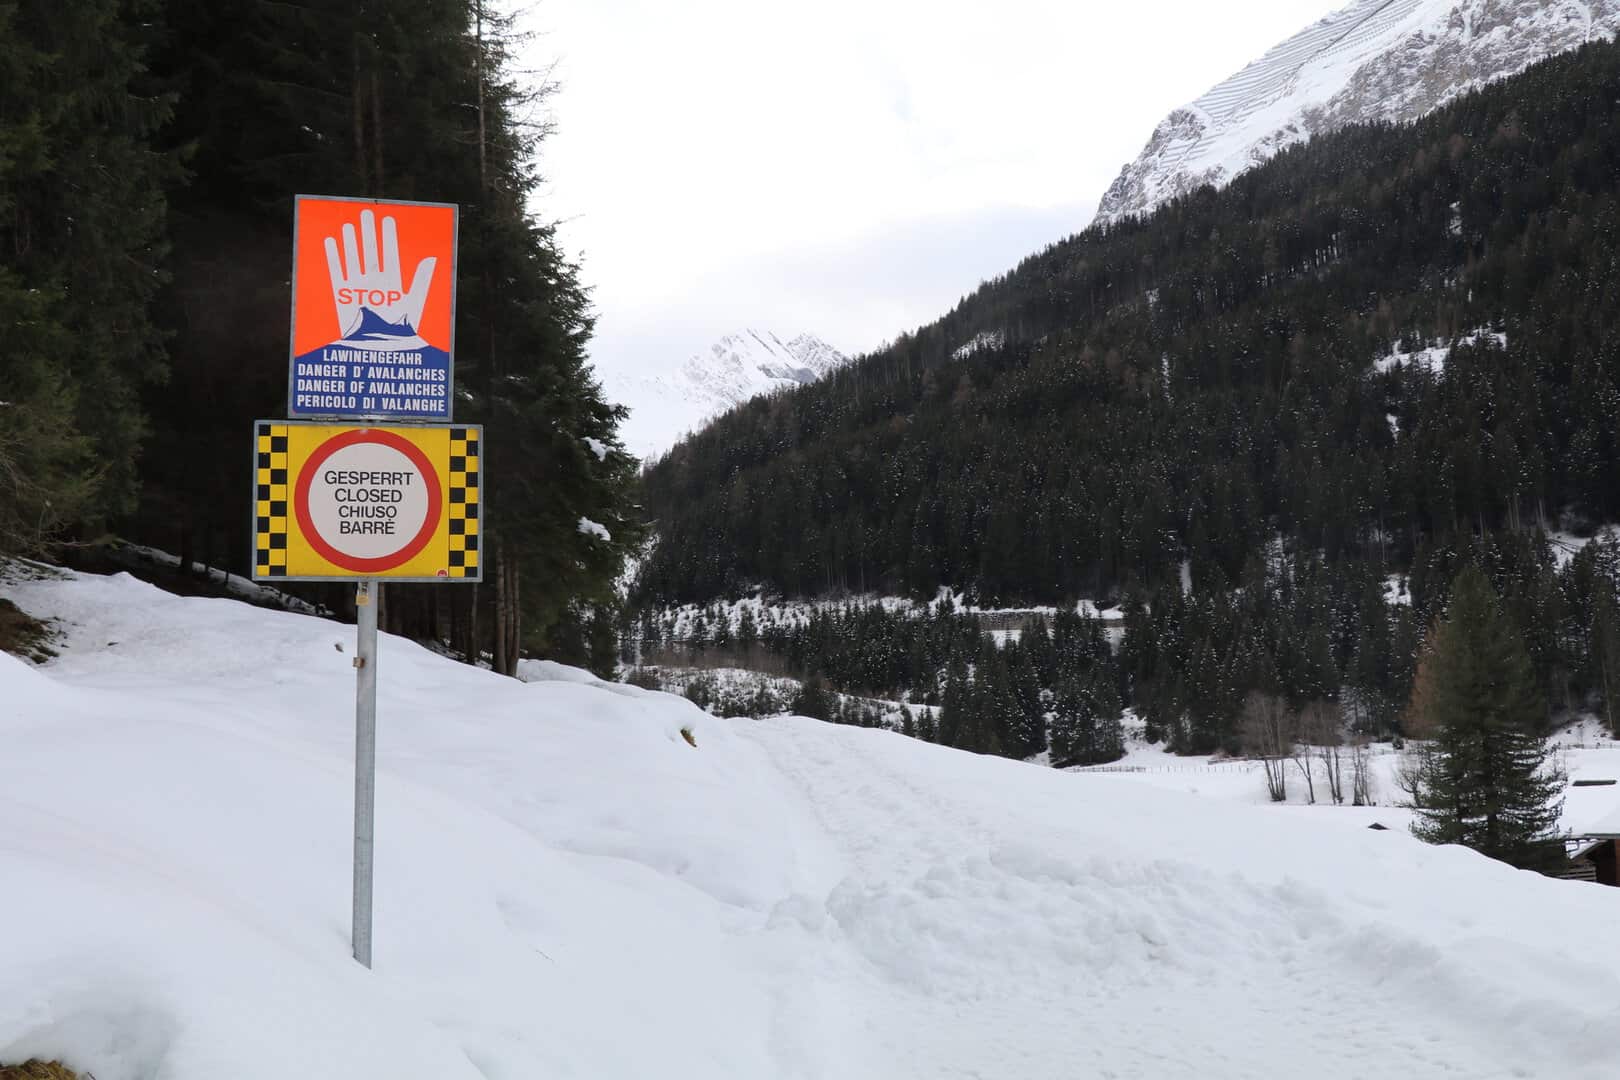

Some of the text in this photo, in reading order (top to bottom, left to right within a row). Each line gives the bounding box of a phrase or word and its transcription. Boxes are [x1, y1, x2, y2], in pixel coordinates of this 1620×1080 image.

[338, 288, 401, 306] STOP
[323, 350, 422, 365] LAWINENGEFAHR
[298, 364, 346, 377] DANGER
[368, 367, 445, 381] AVALANCHES
[297, 379, 445, 396] DANGER OF AVALANCHES
[297, 395, 356, 409] PERICOLO
[363, 397, 375, 409] DI
[382, 398, 445, 412] VALANGHE
[324, 470, 414, 485] GESPERRT
[334, 488, 402, 503] CLOSED
[338, 505, 397, 518] CHIUSO
